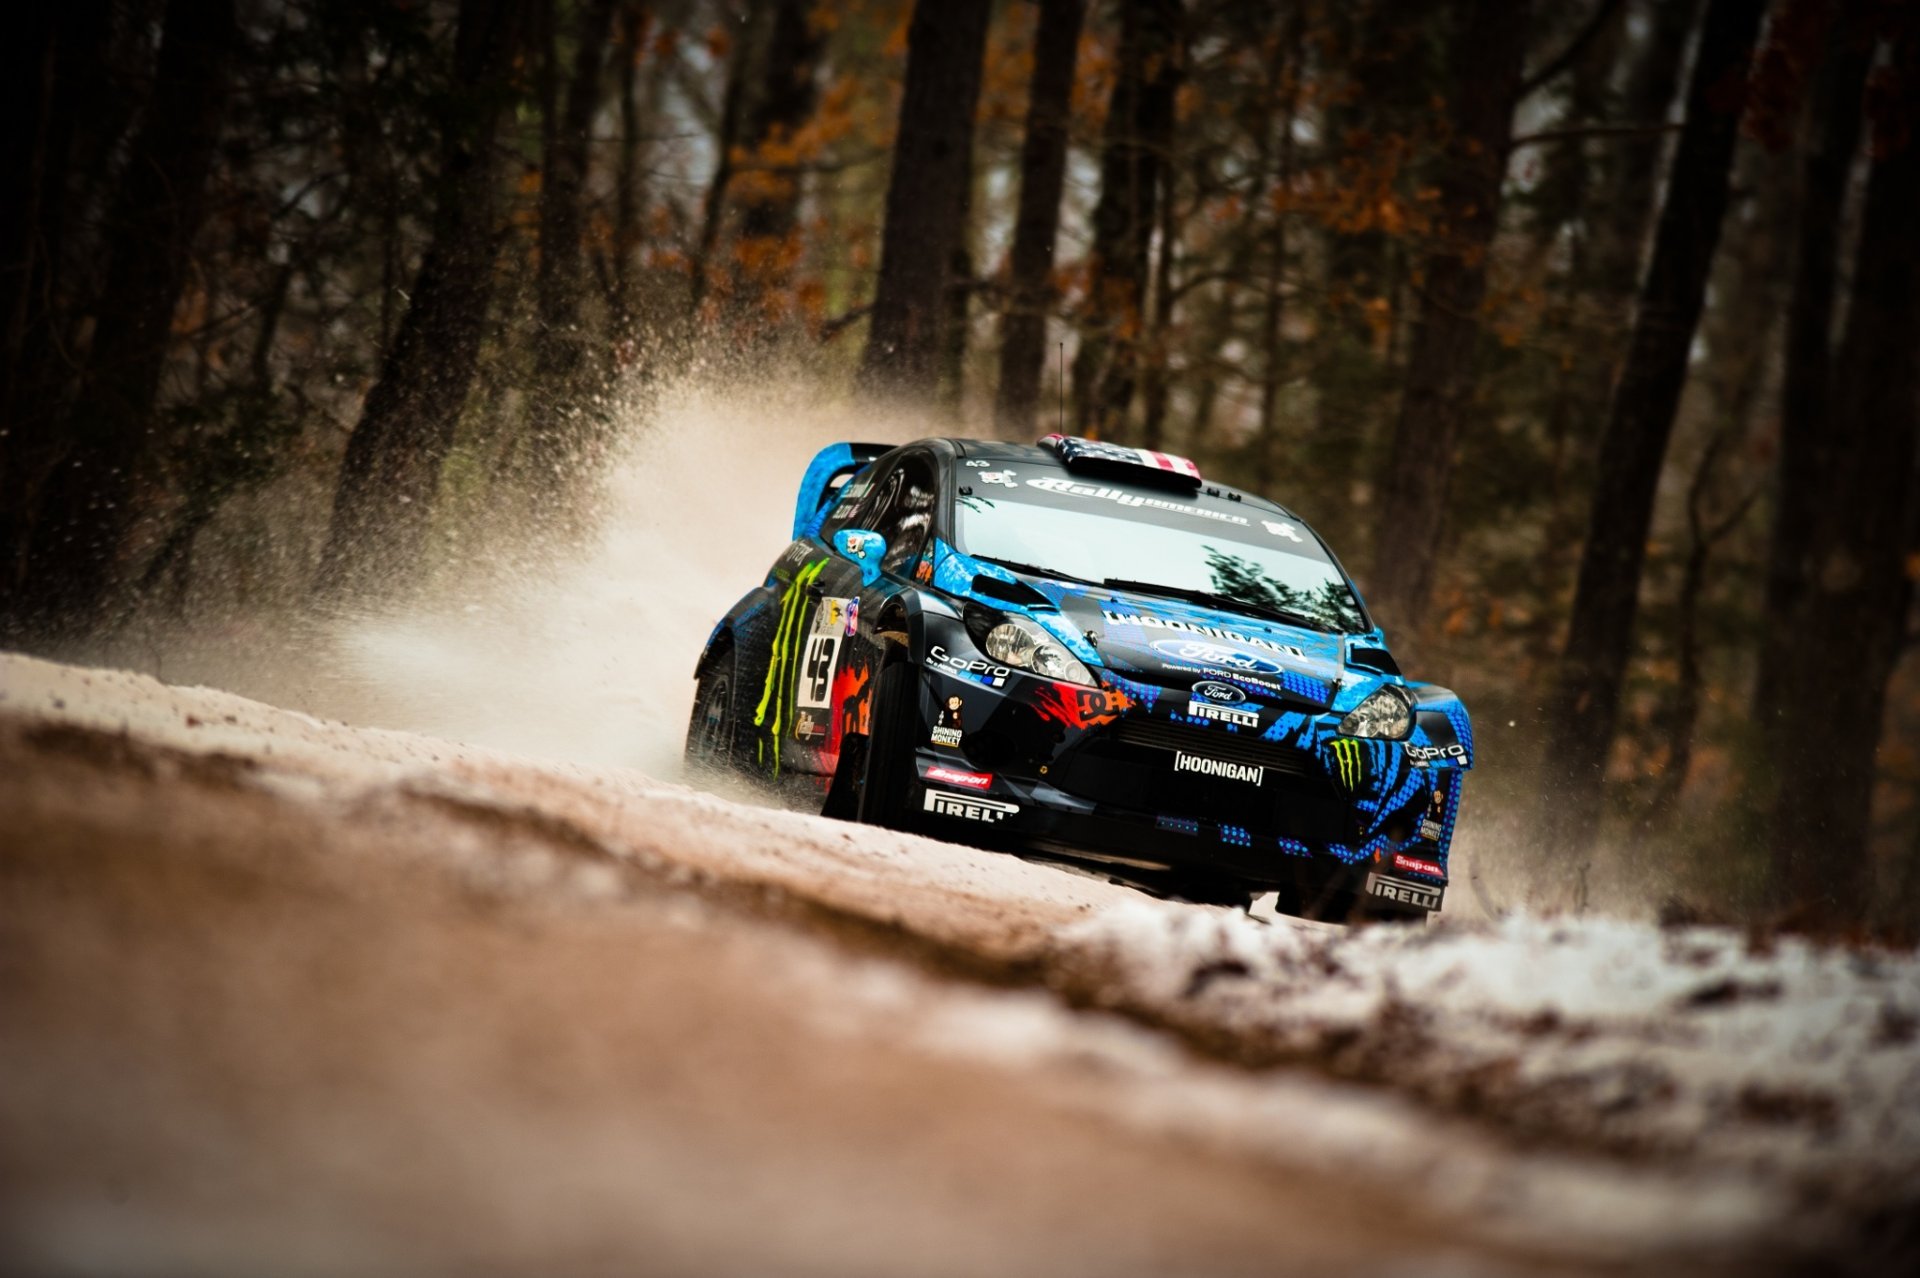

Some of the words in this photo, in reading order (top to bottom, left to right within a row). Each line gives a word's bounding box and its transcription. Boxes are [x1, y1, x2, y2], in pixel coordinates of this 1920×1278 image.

[930, 645, 1010, 677] GoPro
[1180, 643, 1258, 669] Ford
[807, 638, 835, 702] 43
[1162, 663, 1192, 672] Powered
[1203, 667, 1232, 678] FORD
[1233, 673, 1282, 690] EcoBoost
[1204, 684, 1234, 700] Ford
[1188, 700, 1259, 728] PIRELLI
[931, 732, 961, 745] MONKEY
[932, 725, 963, 738] SHINING
[1404, 742, 1464, 760] GoPro
[923, 788, 1020, 823] PIREL
[1395, 855, 1441, 873] Snap-on
[1365, 872, 1441, 909] PIRELLI
